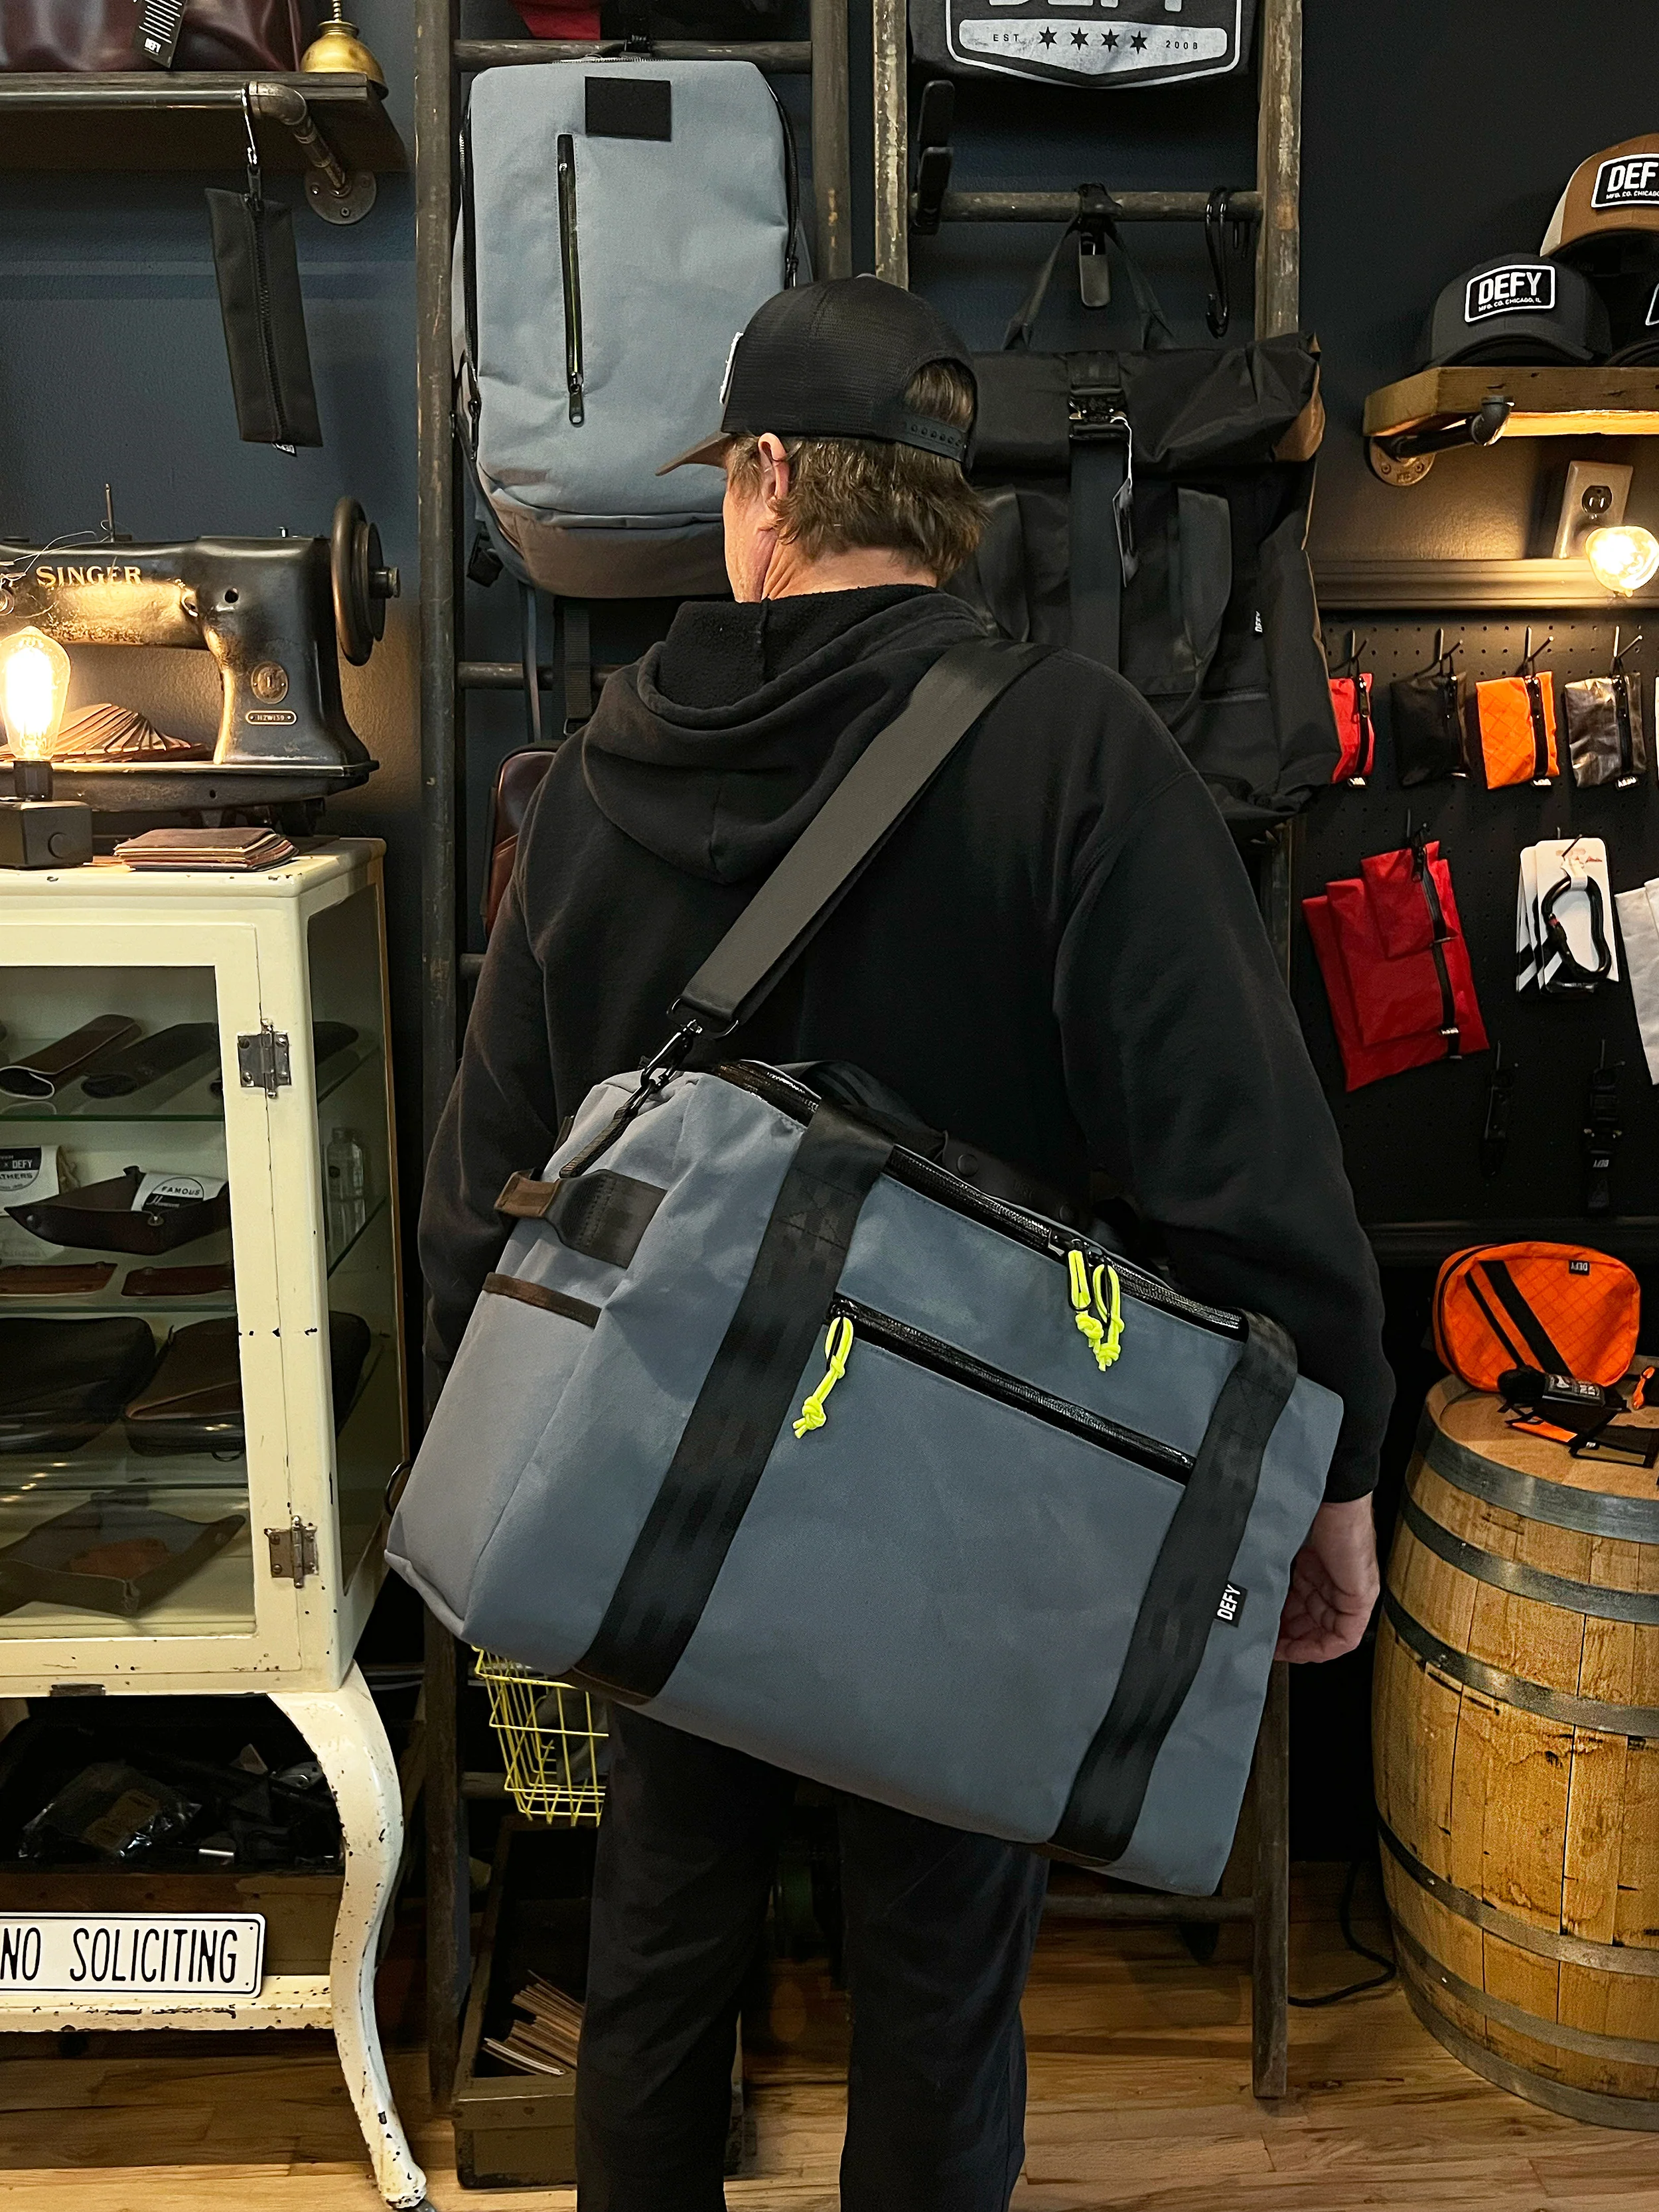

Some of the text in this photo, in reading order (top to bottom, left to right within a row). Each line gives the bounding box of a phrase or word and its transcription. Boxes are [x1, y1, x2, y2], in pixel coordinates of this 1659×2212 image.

[993, 33, 1198, 50] EST 2008
[1607, 161, 1659, 192] DEF
[1478, 271, 1542, 305] DEFY
[36, 565, 144, 588] SINGER
[12, 1159, 33, 1169] DEFY
[161, 1185, 201, 1196] FAMOUS
[1216, 1584, 1241, 1621] DEFY
[0, 1927, 238, 1984] NO SOLICITING
